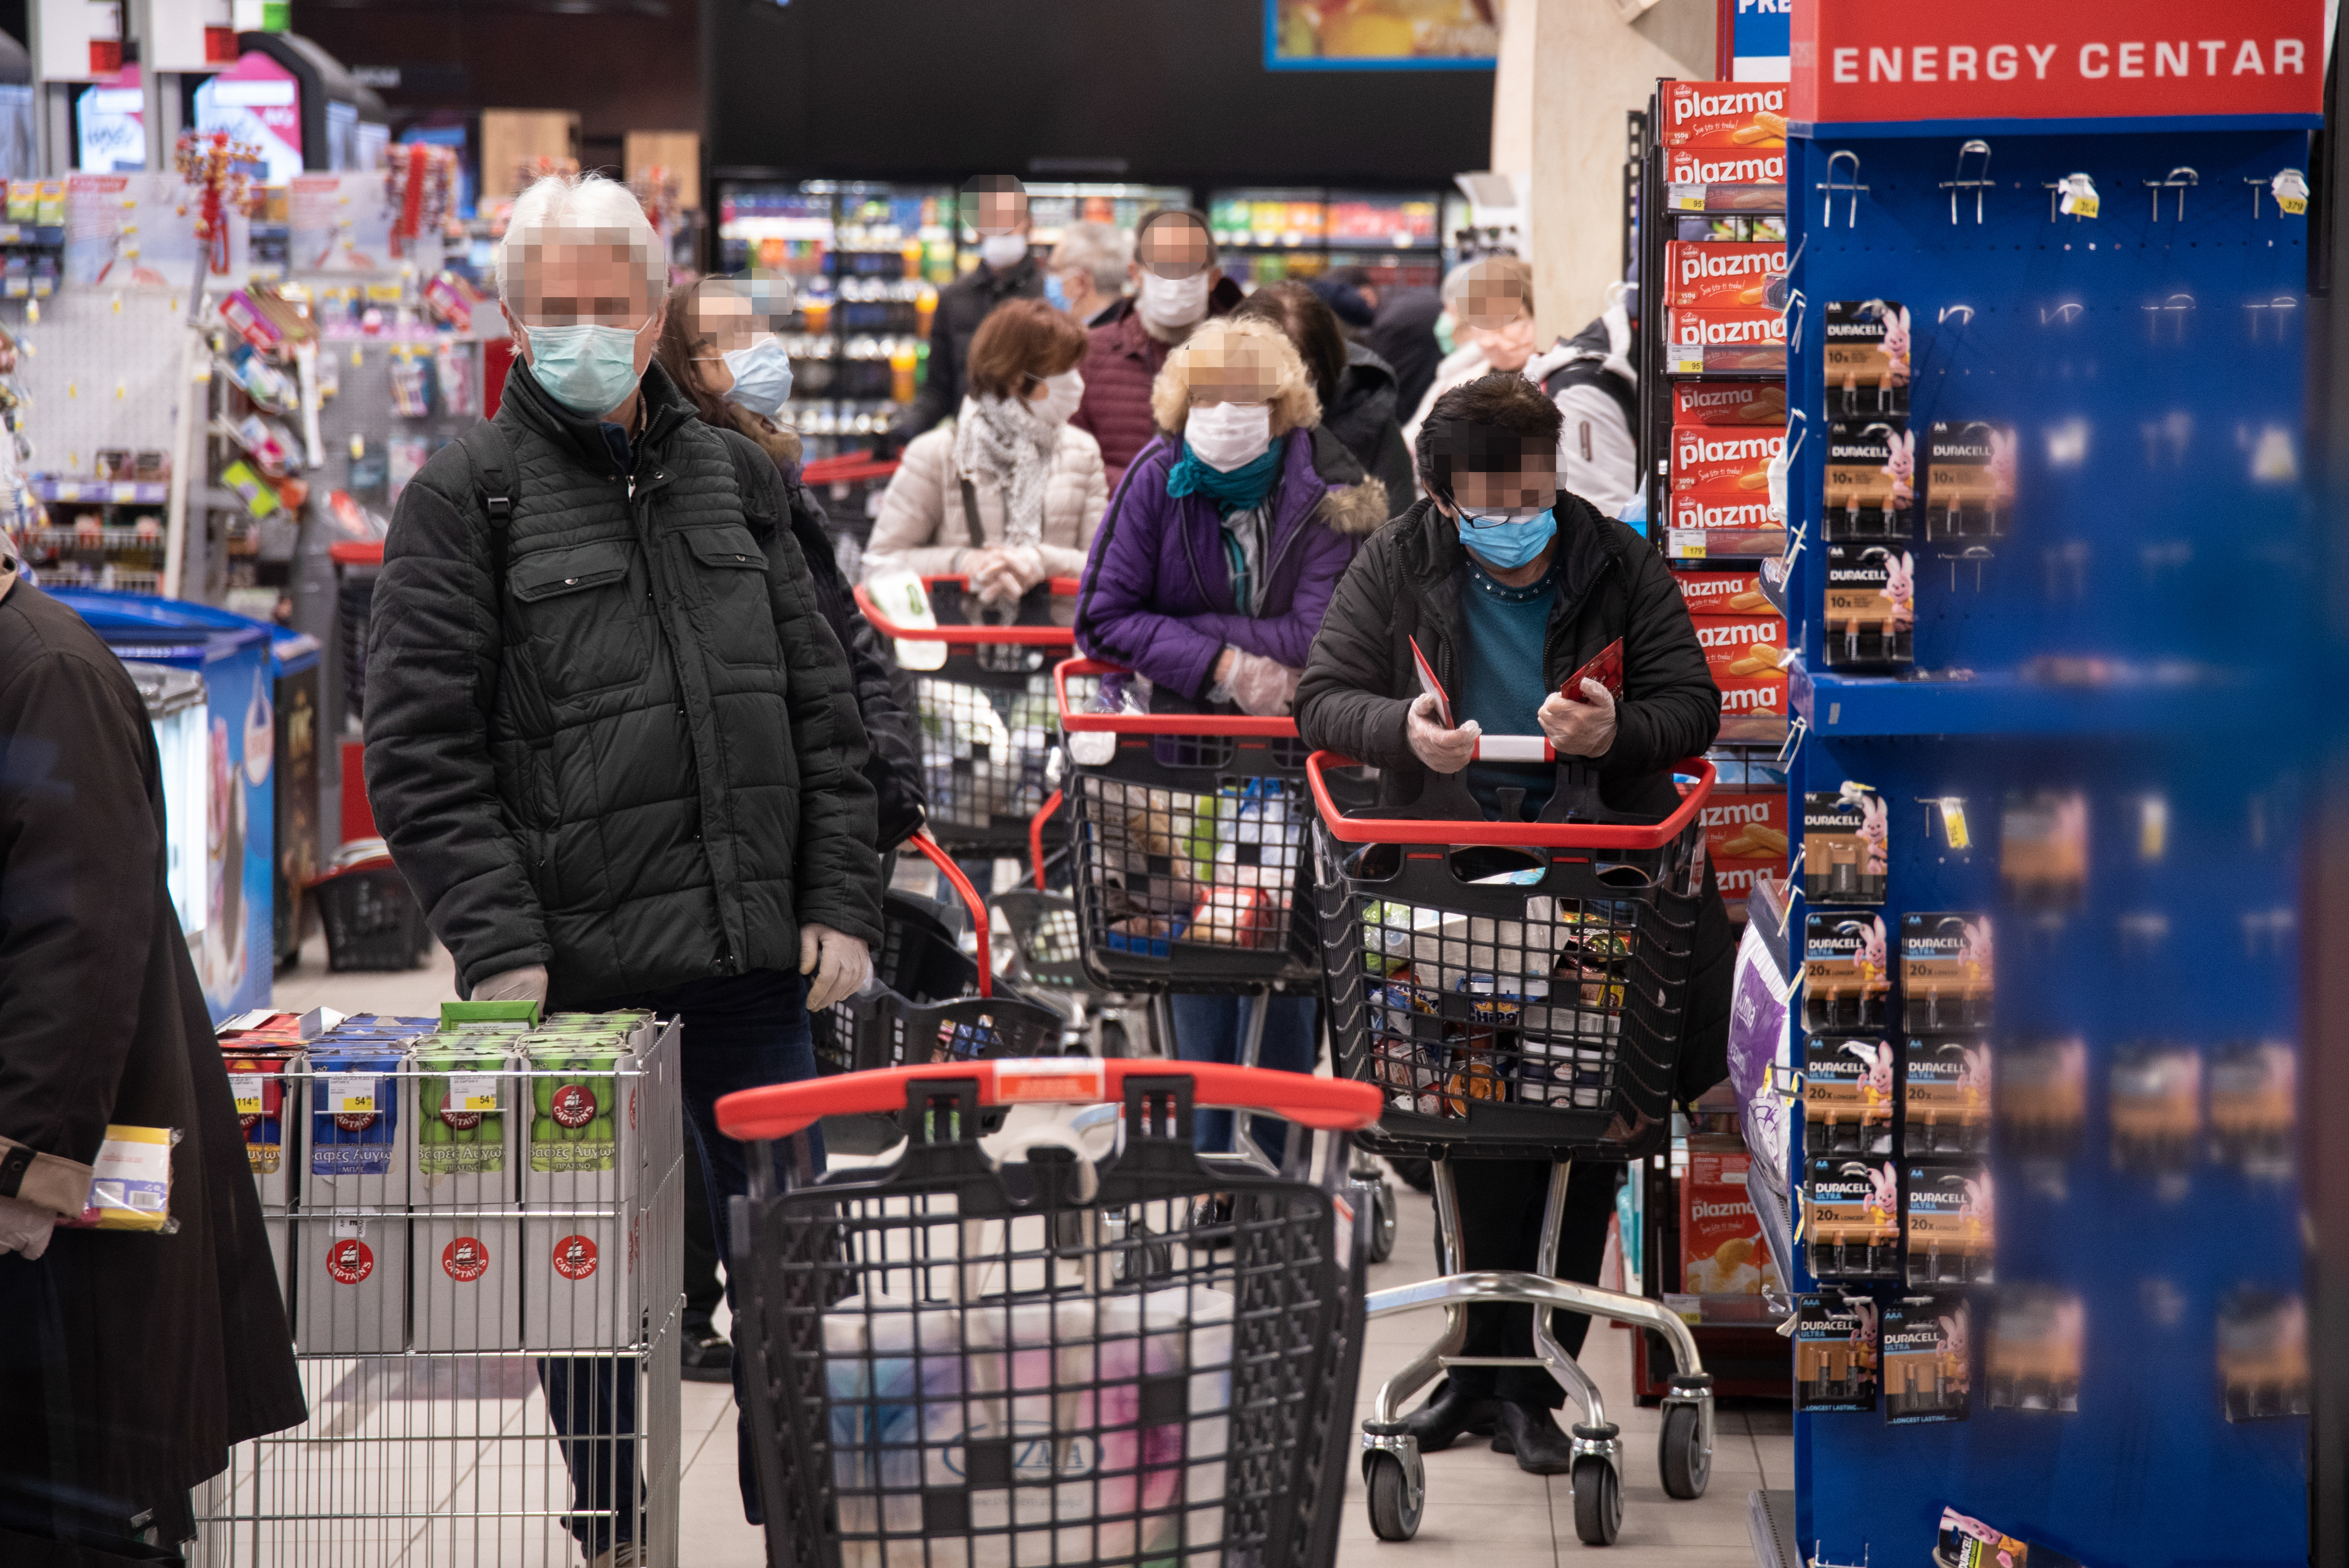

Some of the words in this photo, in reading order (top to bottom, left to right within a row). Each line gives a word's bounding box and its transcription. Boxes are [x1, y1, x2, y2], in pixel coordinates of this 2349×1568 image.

[1833, 44, 2058, 83] ENERGY
[2079, 38, 2306, 79] CENTAR
[1675, 90, 1783, 125] plazma
[1675, 156, 1784, 184] plazma
[1682, 252, 1787, 285] plazma
[1681, 318, 1787, 345] plazma
[1827, 324, 1886, 336] DURACELL
[1681, 389, 1753, 412] plazma
[1679, 437, 1785, 470] plazma
[1832, 445, 1889, 457] DURACELL
[1933, 445, 1992, 456] DURACELL
[1830, 570, 1887, 581] DURACELL
[1831, 597, 1851, 608] 10x
[1804, 815, 1861, 826] DURACELL
[1808, 939, 1862, 949] DURACELL
[1908, 938, 1965, 949] DURACELL
[1809, 964, 1831, 976] 20x
[1909, 964, 1933, 976] 20x
[1809, 1061, 1866, 1073] DURACELL
[1908, 1062, 1965, 1073] DURACELL
[1809, 1088, 1832, 1099] 20x
[1908, 1088, 1932, 1099] 20x
[237, 1097, 252, 1106] 114
[355, 1096, 365, 1105] 54
[480, 1095, 490, 1104] 54
[1815, 1183, 1872, 1193] DURACELL
[1910, 1192, 1967, 1203] DURACELL
[1816, 1210, 1839, 1220] 20x
[1911, 1218, 1934, 1230] 20x
[1801, 1321, 1855, 1331] DURACELL
[1884, 1332, 1940, 1344] DURACELL
